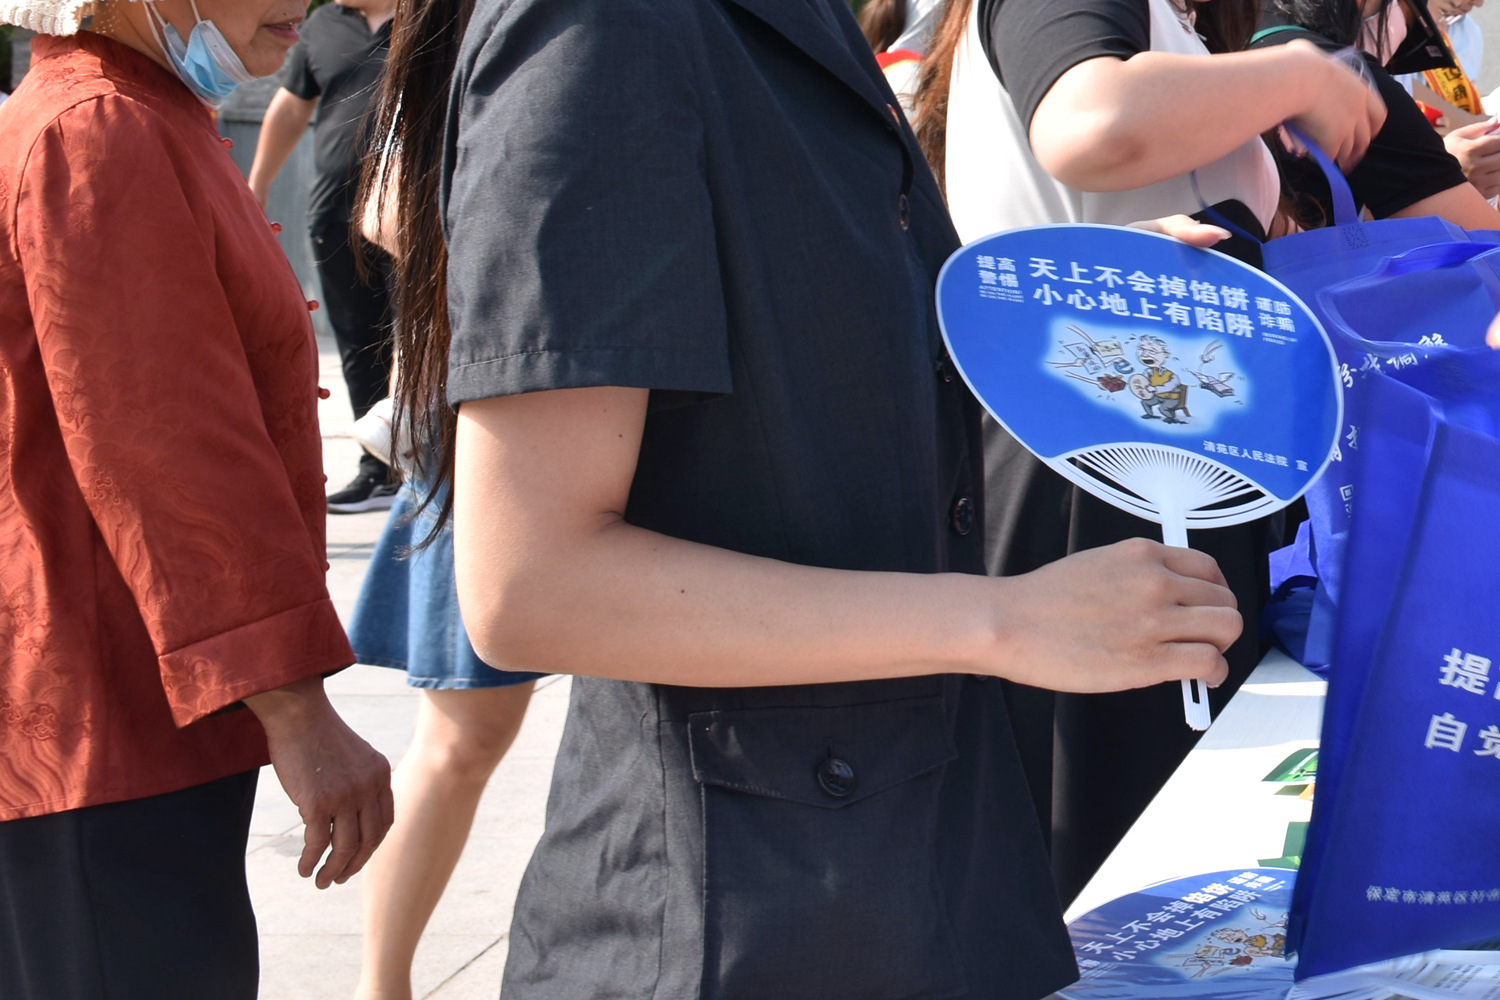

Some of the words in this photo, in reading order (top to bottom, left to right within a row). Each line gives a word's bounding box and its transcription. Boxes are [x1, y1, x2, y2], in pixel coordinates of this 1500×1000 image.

[976, 254, 1017, 273] 提高
[977, 269, 1019, 288] 警惕
[1028, 257, 1250, 311] 天上不会掉馅饼
[1032, 283, 1255, 338] 小心地上有陷阱
[1257, 312, 1296, 333] 诈骗
[1203, 440, 1289, 467] 清苑区人民法院
[1080, 883, 1236, 955] 天上不会掉馅饼
[1112, 890, 1262, 961] 小心地上有陷阱
